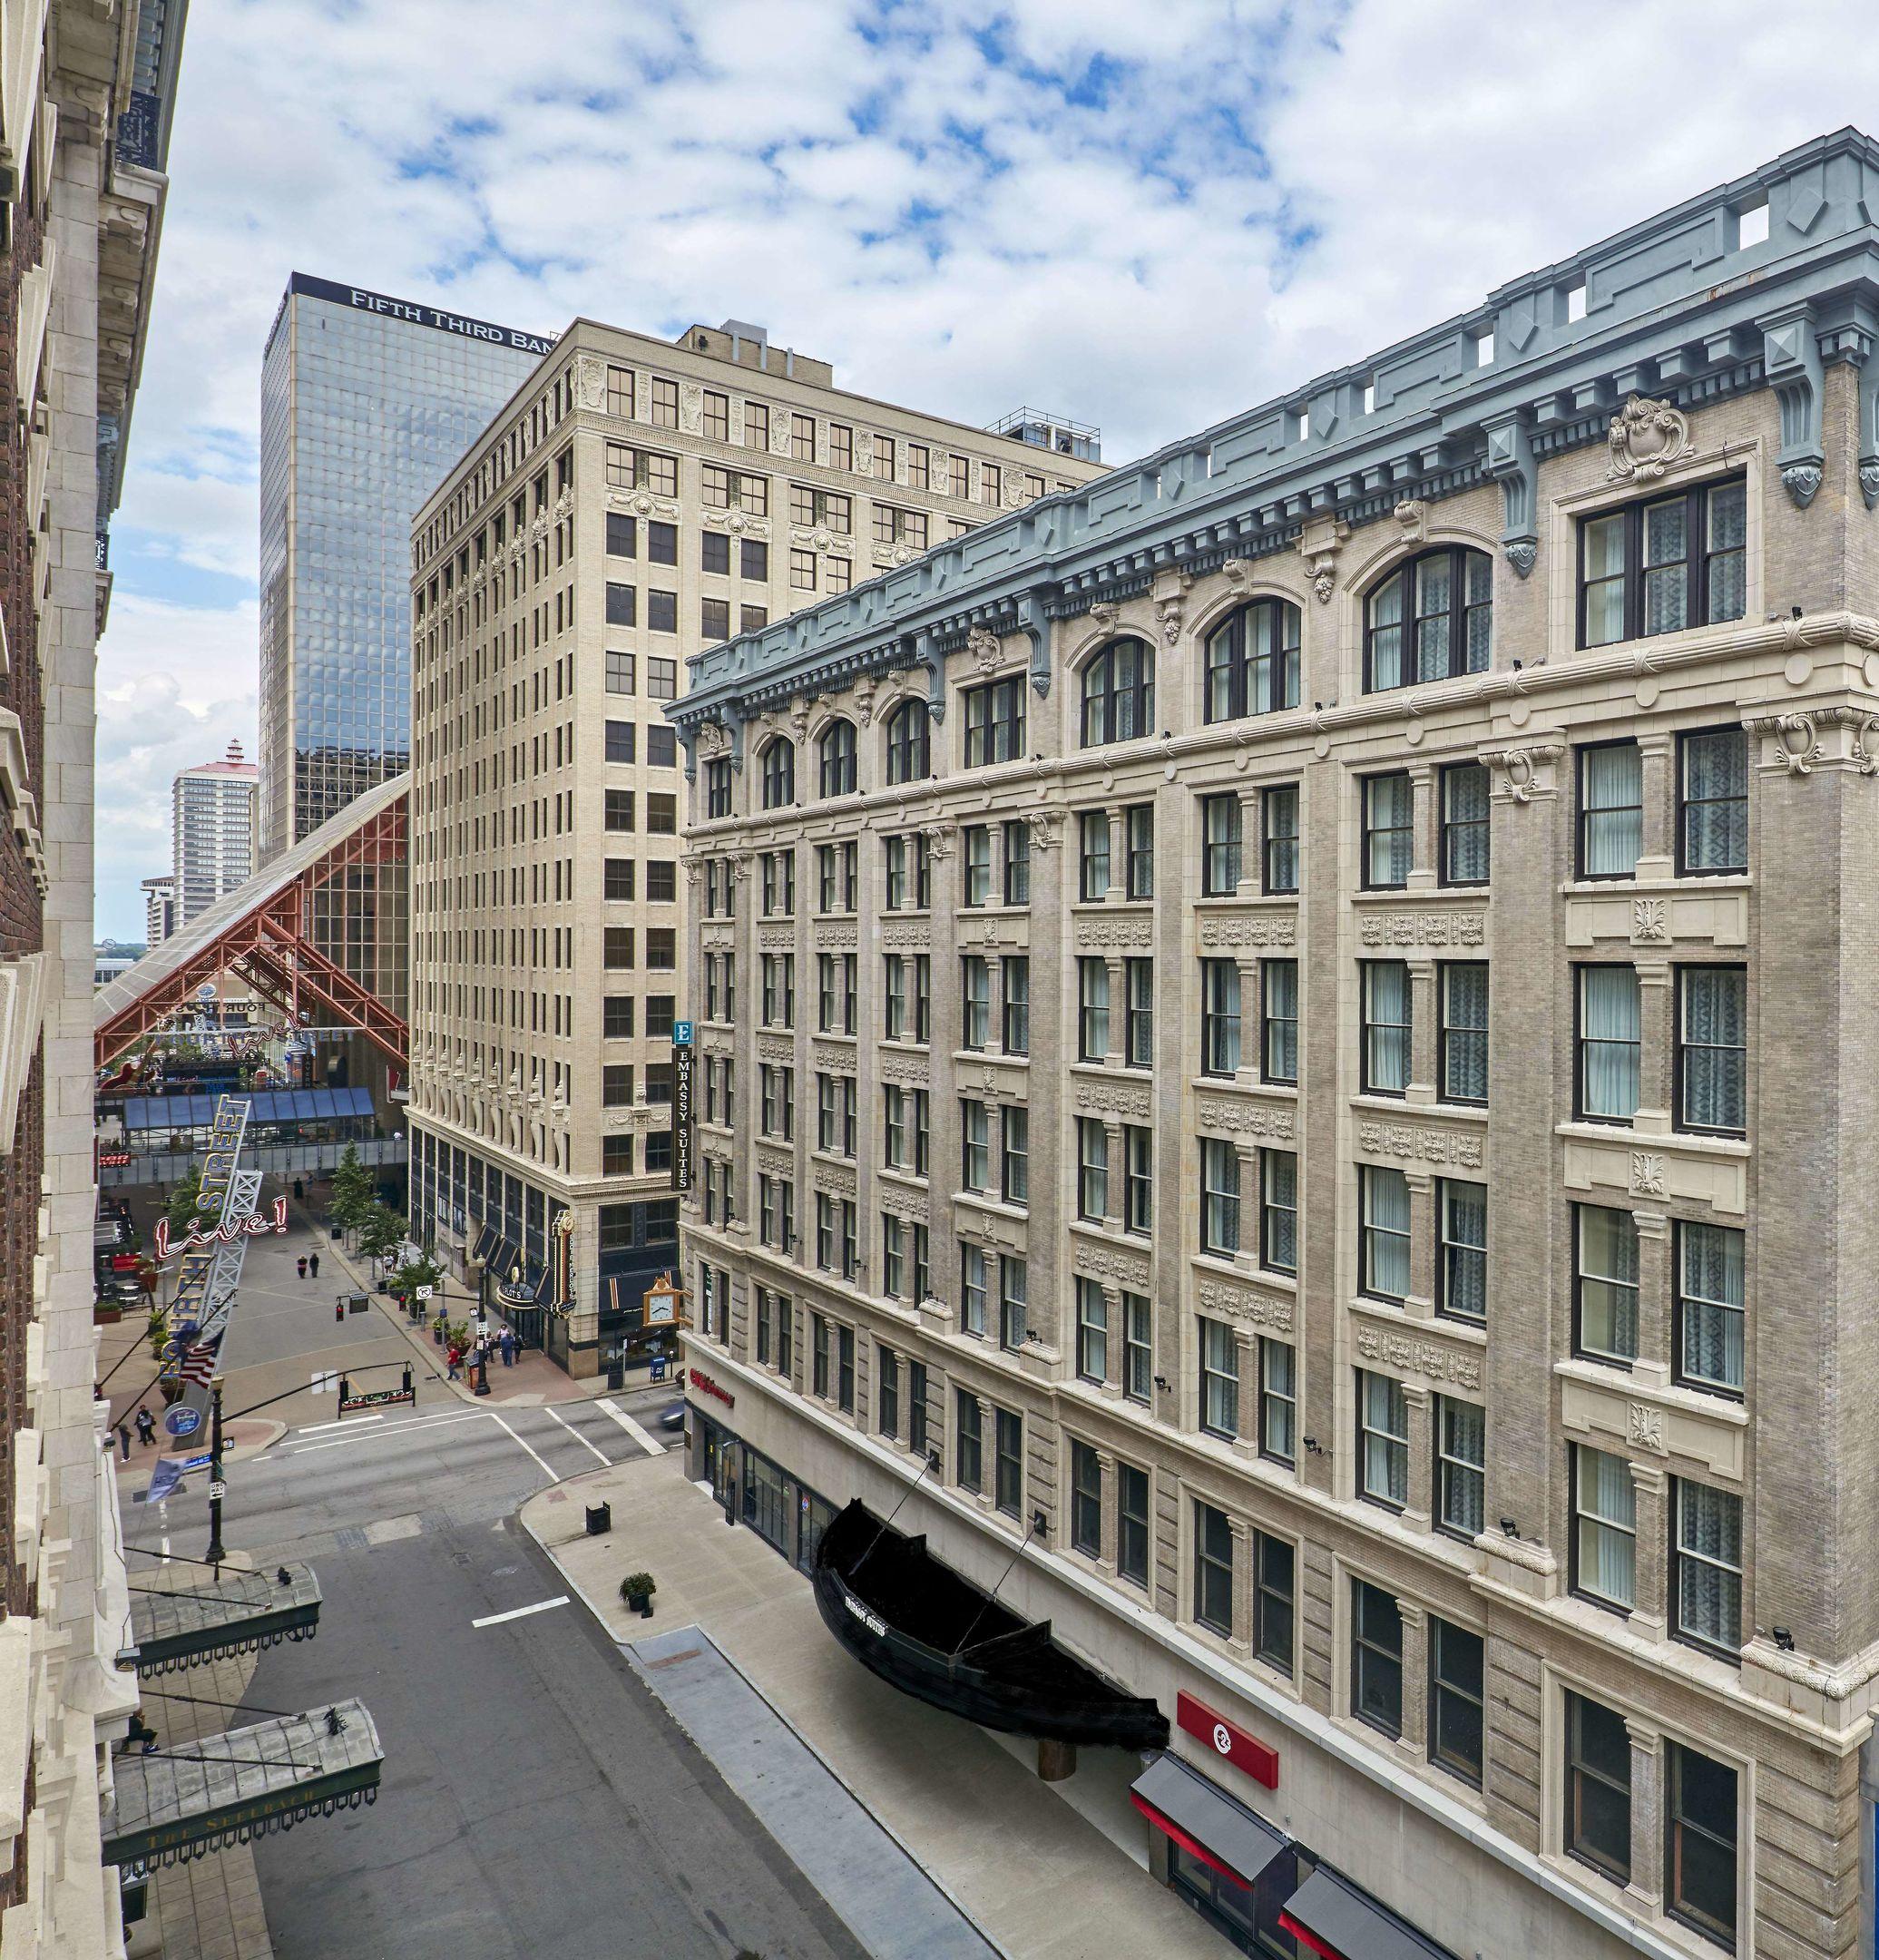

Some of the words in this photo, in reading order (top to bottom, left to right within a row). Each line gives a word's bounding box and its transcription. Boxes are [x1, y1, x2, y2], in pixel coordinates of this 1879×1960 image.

[351, 289, 422, 322] FIFTH
[430, 310, 504, 342] THIRD
[510, 331, 556, 355] BAN
[228, 1012, 301, 1057] Live!
[677, 1052, 690, 1122] EMBASSY
[196, 1094, 248, 1210] STREET
[679, 1128, 689, 1188] SUITES
[153, 1195, 289, 1261] Live!
